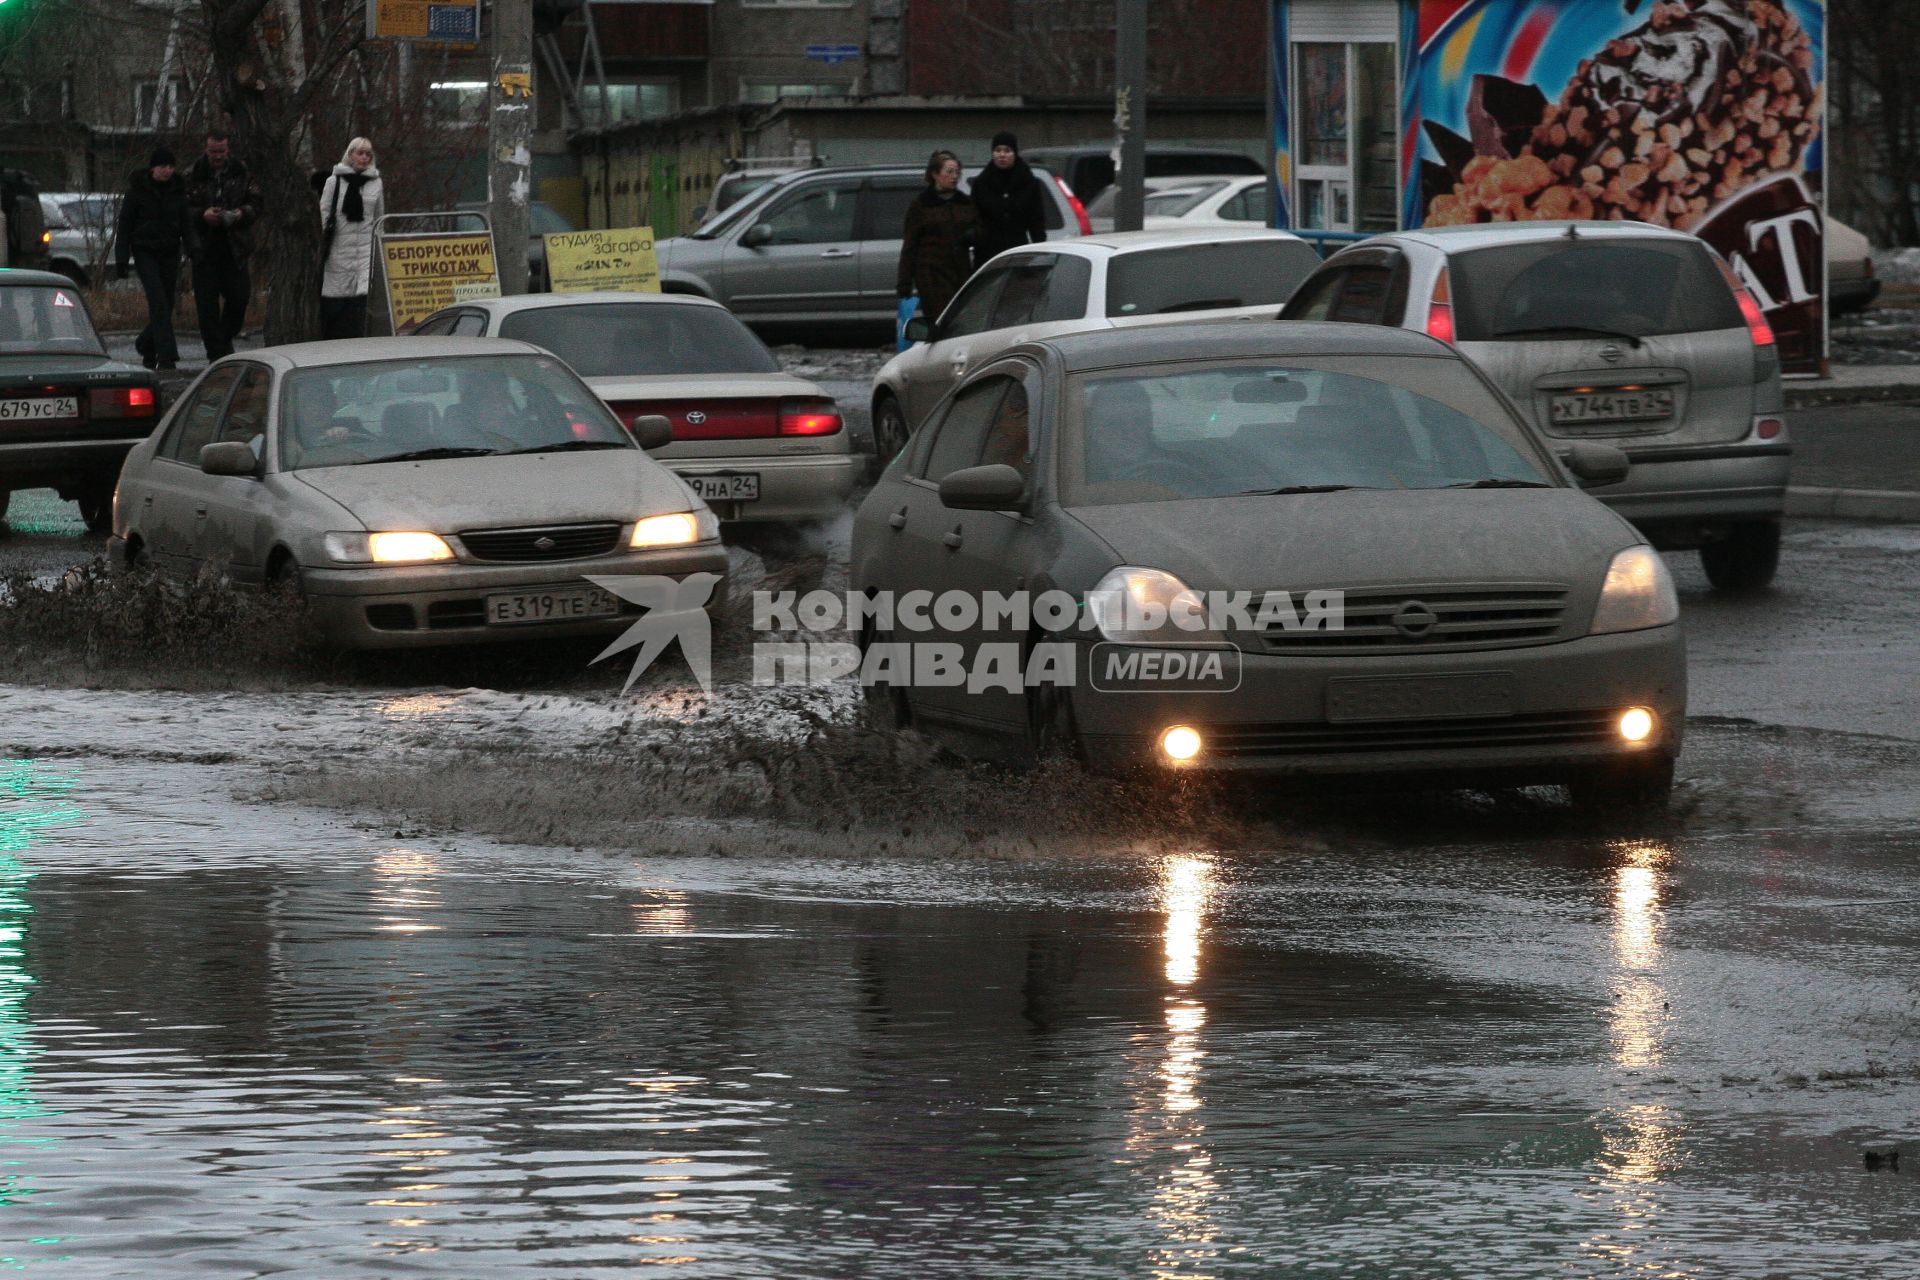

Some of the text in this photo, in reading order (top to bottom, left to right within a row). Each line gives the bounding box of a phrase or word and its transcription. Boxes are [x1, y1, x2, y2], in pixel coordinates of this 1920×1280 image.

[550, 233, 603, 248] СТУДИЯ
[593, 240, 652, 255] загара
[388, 242, 490, 260] БЕЛОРУССКИЙ
[402, 260, 480, 275] ТРИКОТАЖ
